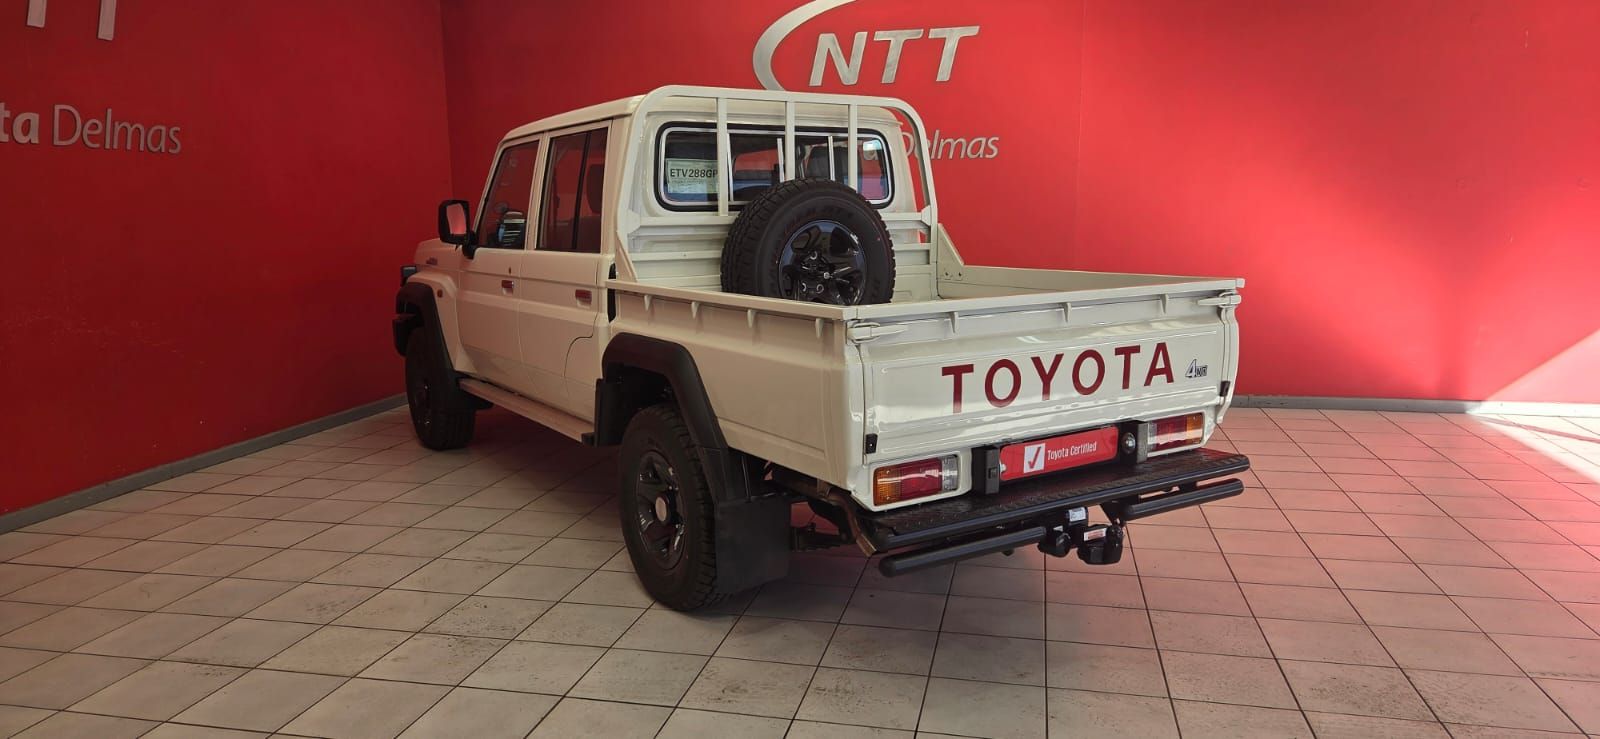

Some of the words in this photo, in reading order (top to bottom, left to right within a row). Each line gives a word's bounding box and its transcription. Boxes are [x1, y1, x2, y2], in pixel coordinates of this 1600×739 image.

[809, 25, 980, 87] NTT
[53, 103, 182, 154] Delmas
[901, 128, 1000, 161] Dlmas
[670, 168, 718, 178] ETV288GP
[941, 342, 1175, 414] TOYOTA
[1047, 447, 1069, 461] Toyota
[1070, 441, 1097, 456] Certified
